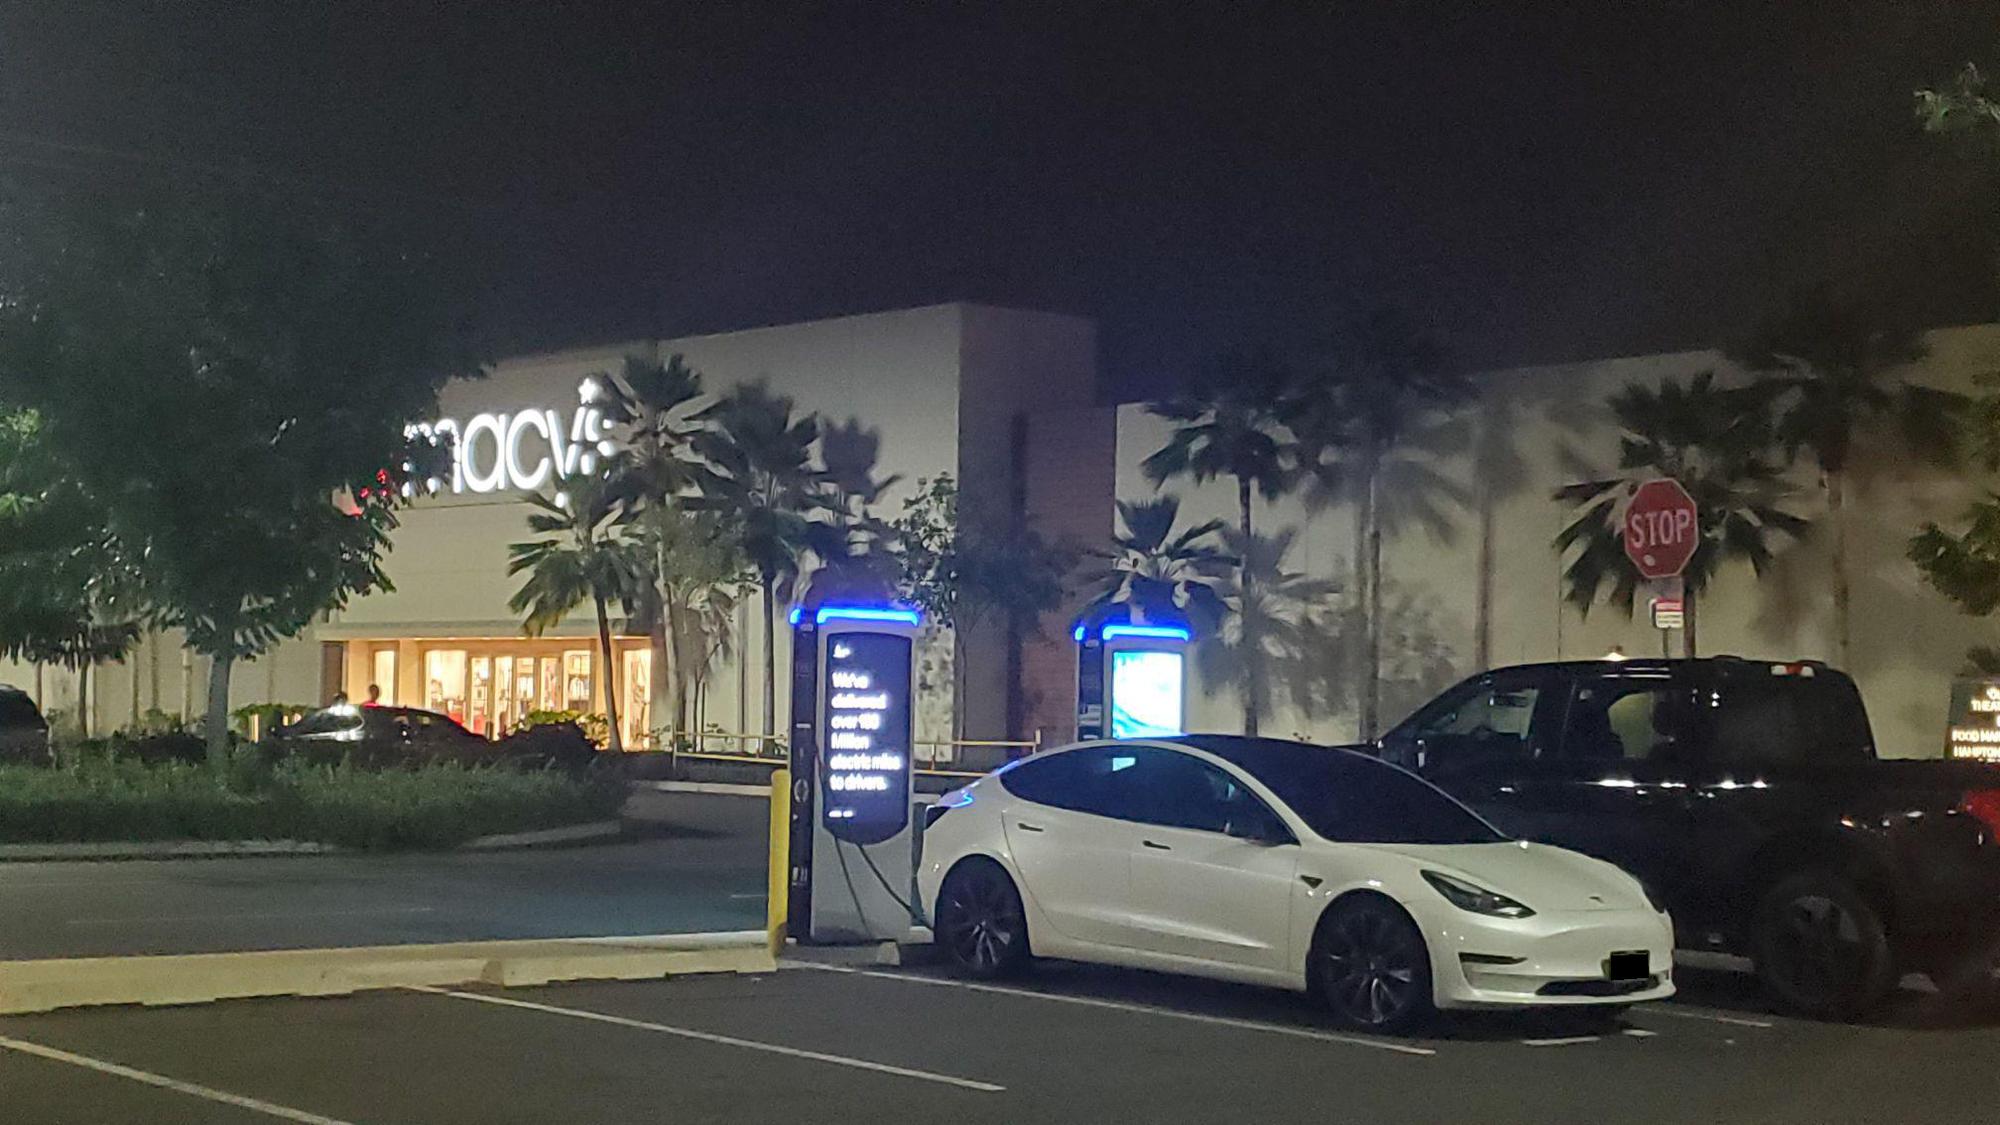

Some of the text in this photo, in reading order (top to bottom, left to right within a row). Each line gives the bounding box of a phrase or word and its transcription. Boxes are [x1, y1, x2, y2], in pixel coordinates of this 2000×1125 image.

[1631, 508, 1689, 549] STOP
[831, 714, 857, 730] over
[831, 732, 869, 750] Million
[830, 753, 901, 770] electric miles
[830, 774, 844, 791] to
